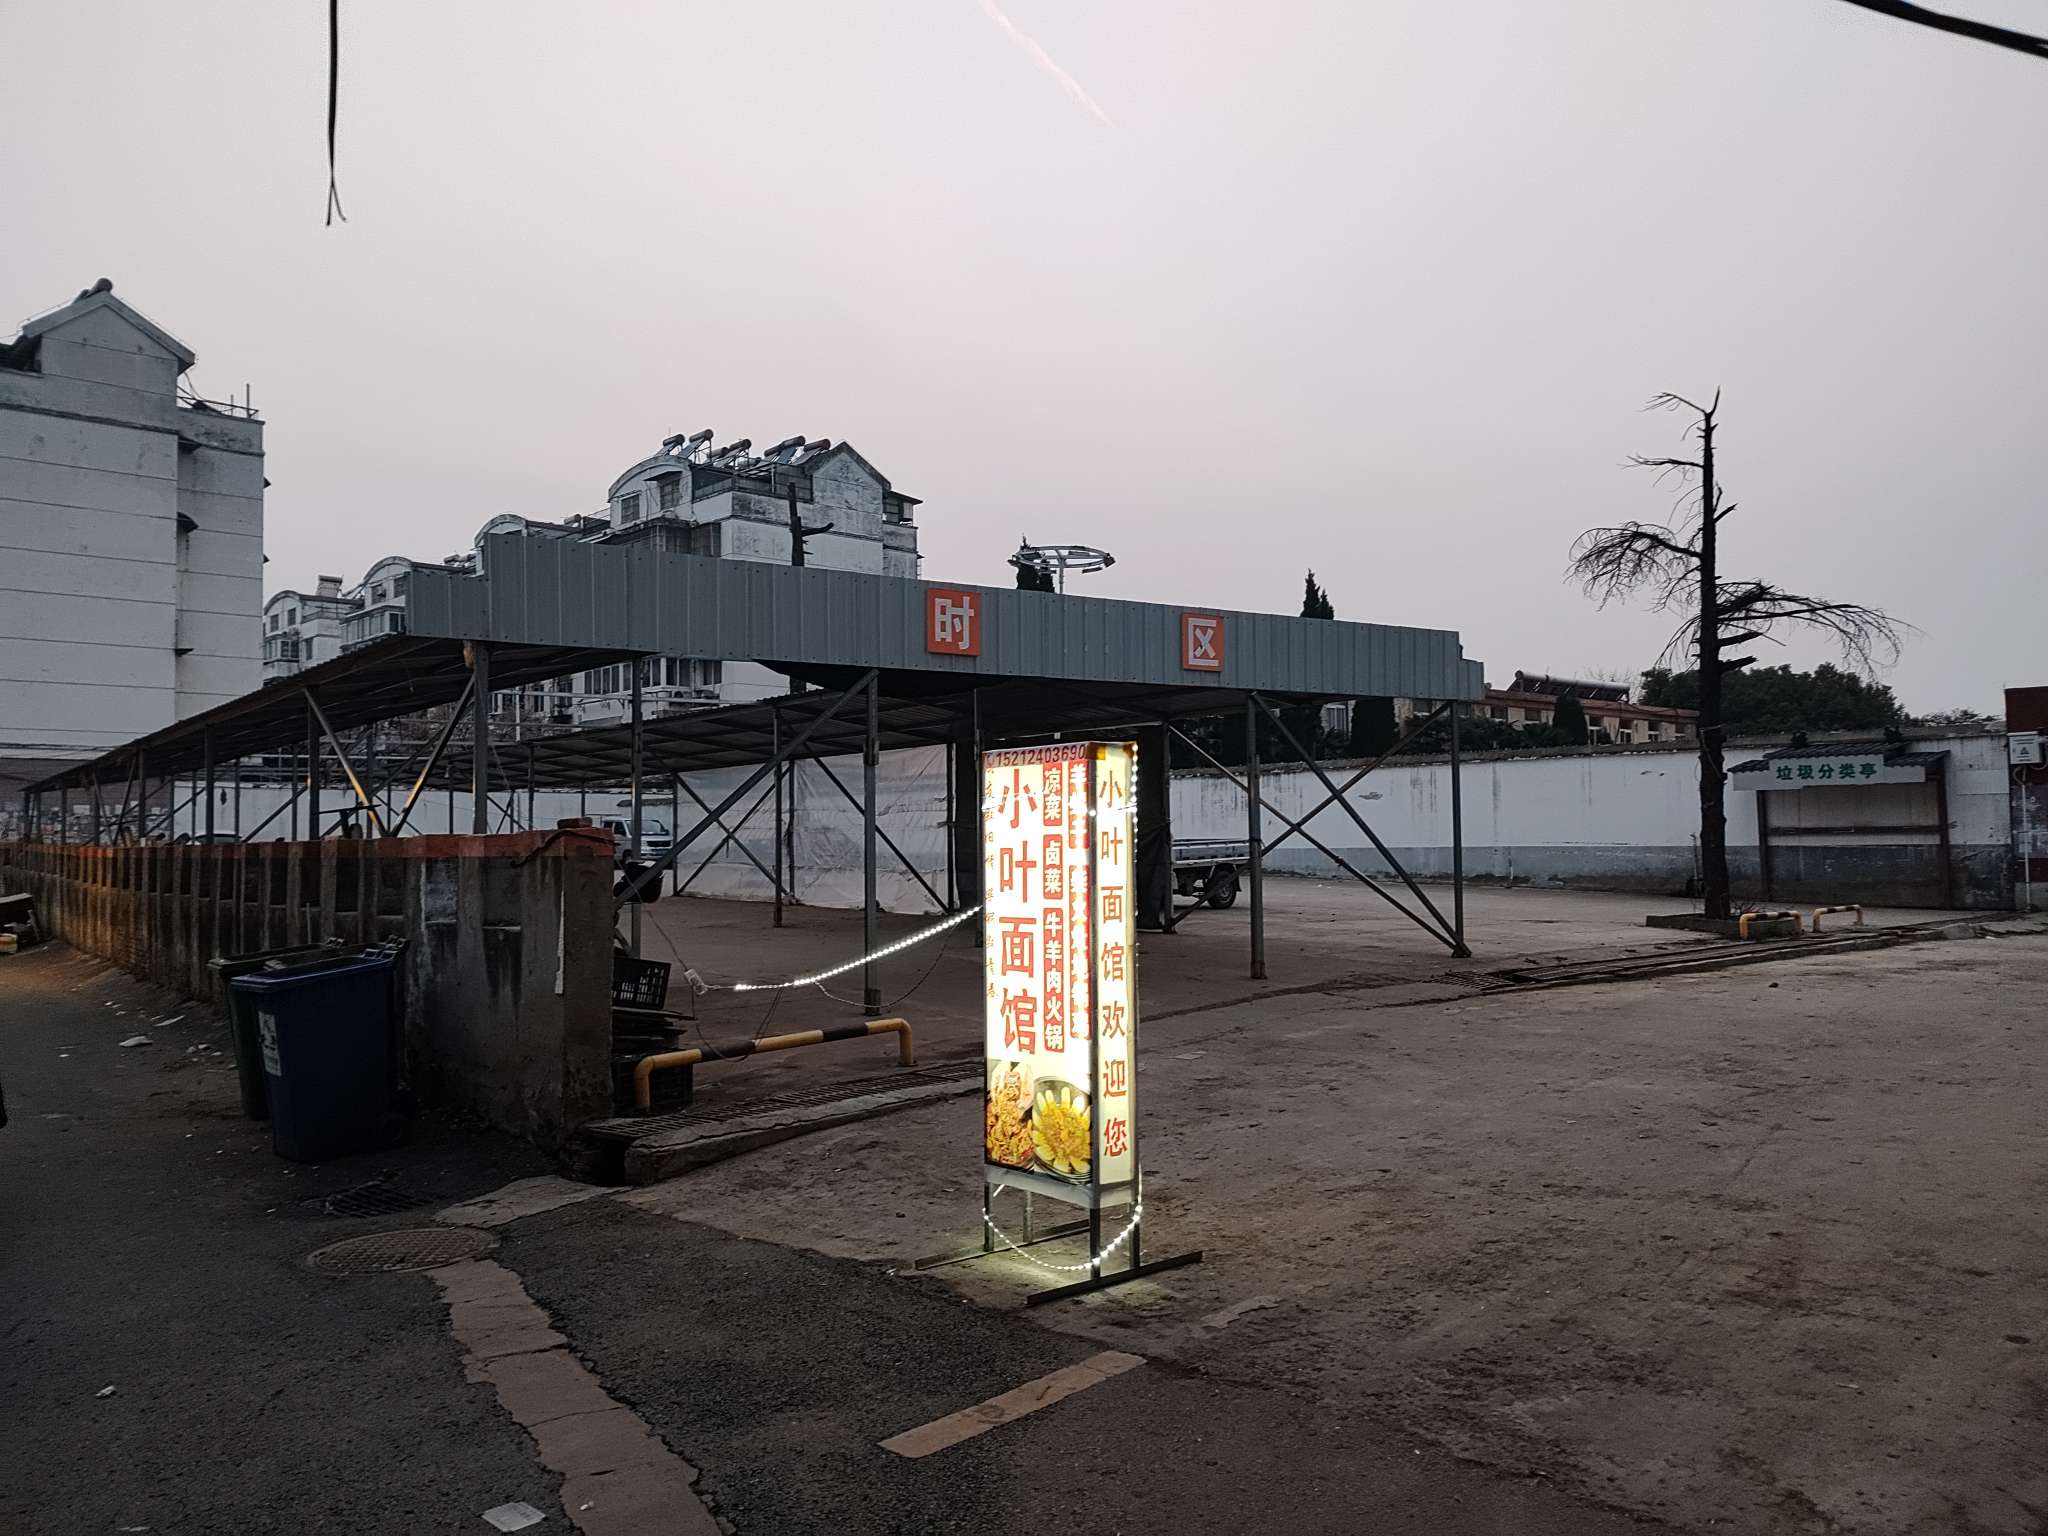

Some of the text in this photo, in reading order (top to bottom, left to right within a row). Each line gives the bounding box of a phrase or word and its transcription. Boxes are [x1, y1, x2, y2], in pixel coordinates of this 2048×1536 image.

[934, 596, 1219, 666] 时 区
[996, 744, 1086, 766] 15212403690
[1776, 763, 1877, 781] 垃圾分类亭
[1045, 840, 1062, 894] 卤菜
[998, 768, 1037, 1055] 小叶面馆
[1045, 912, 1064, 1050] 牛羊肉火锅
[1099, 770, 1128, 1157] 小叶面馆欢迎您
